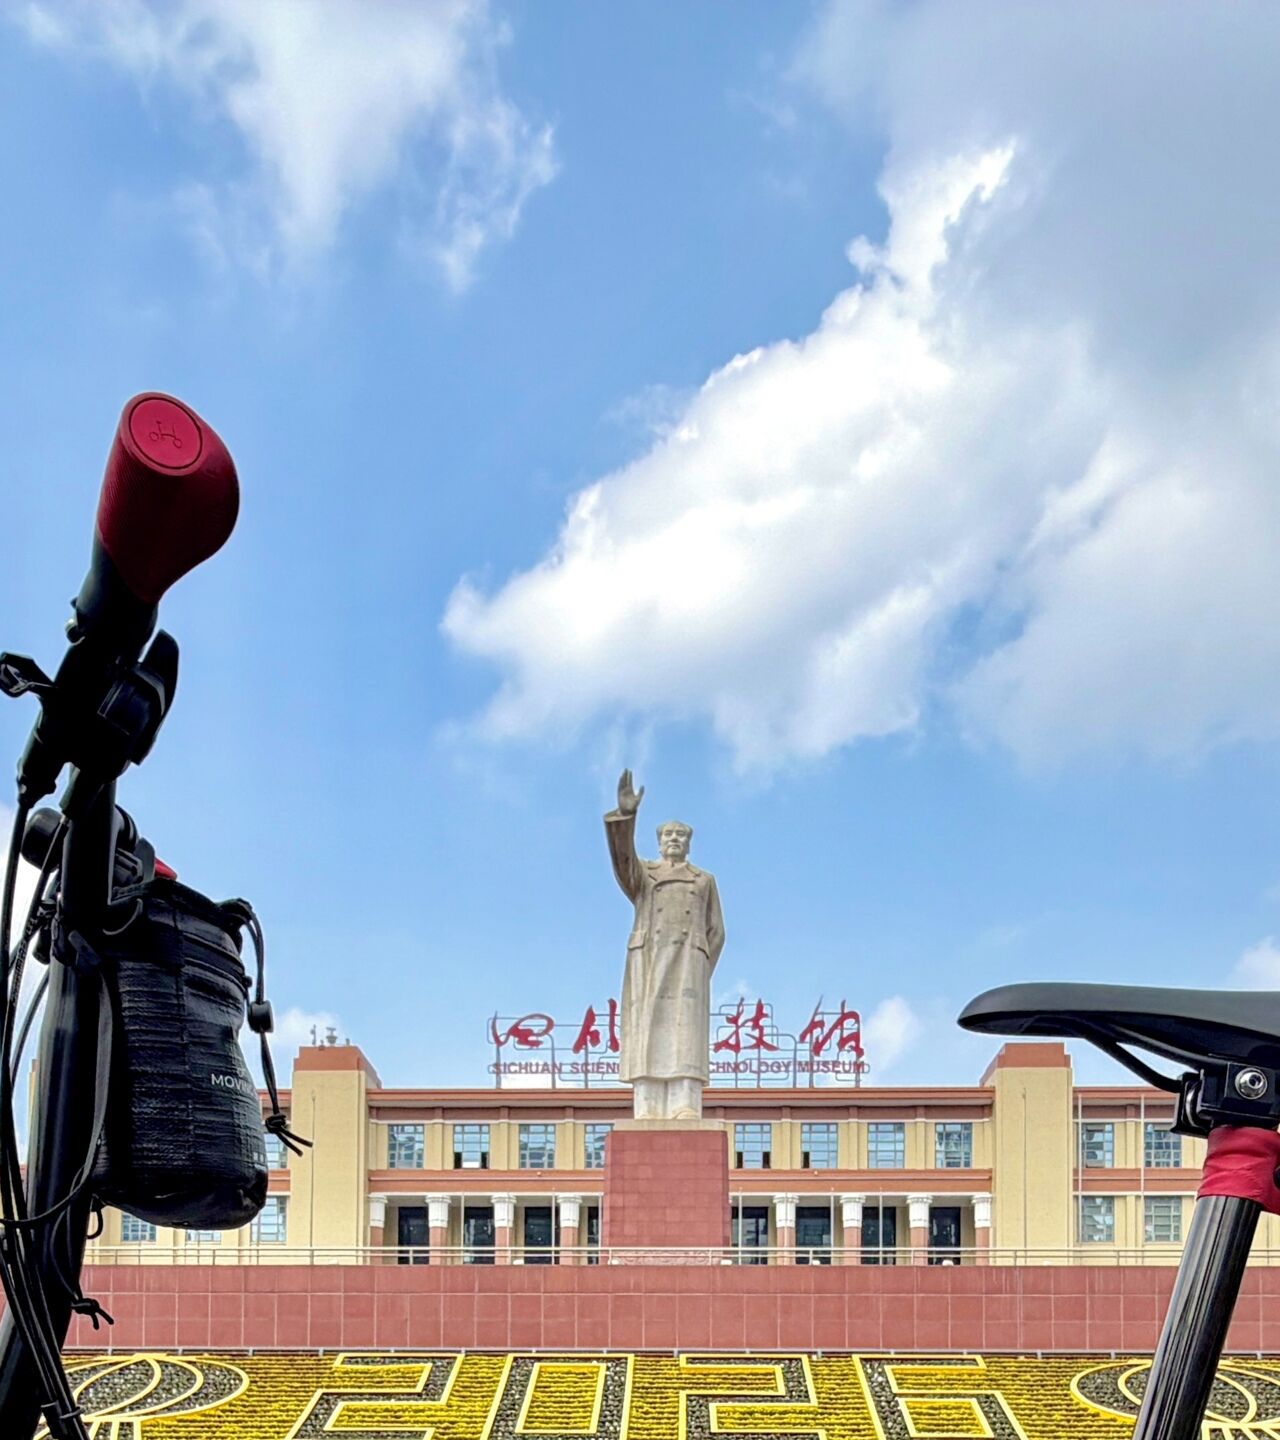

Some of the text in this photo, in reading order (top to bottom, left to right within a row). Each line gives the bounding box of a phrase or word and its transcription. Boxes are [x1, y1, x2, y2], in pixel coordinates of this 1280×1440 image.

[491, 995, 864, 1059] 四川技馆
[490, 1061, 865, 1075] SICHUAN SCIEN CHNOLOGY MUSEUM
